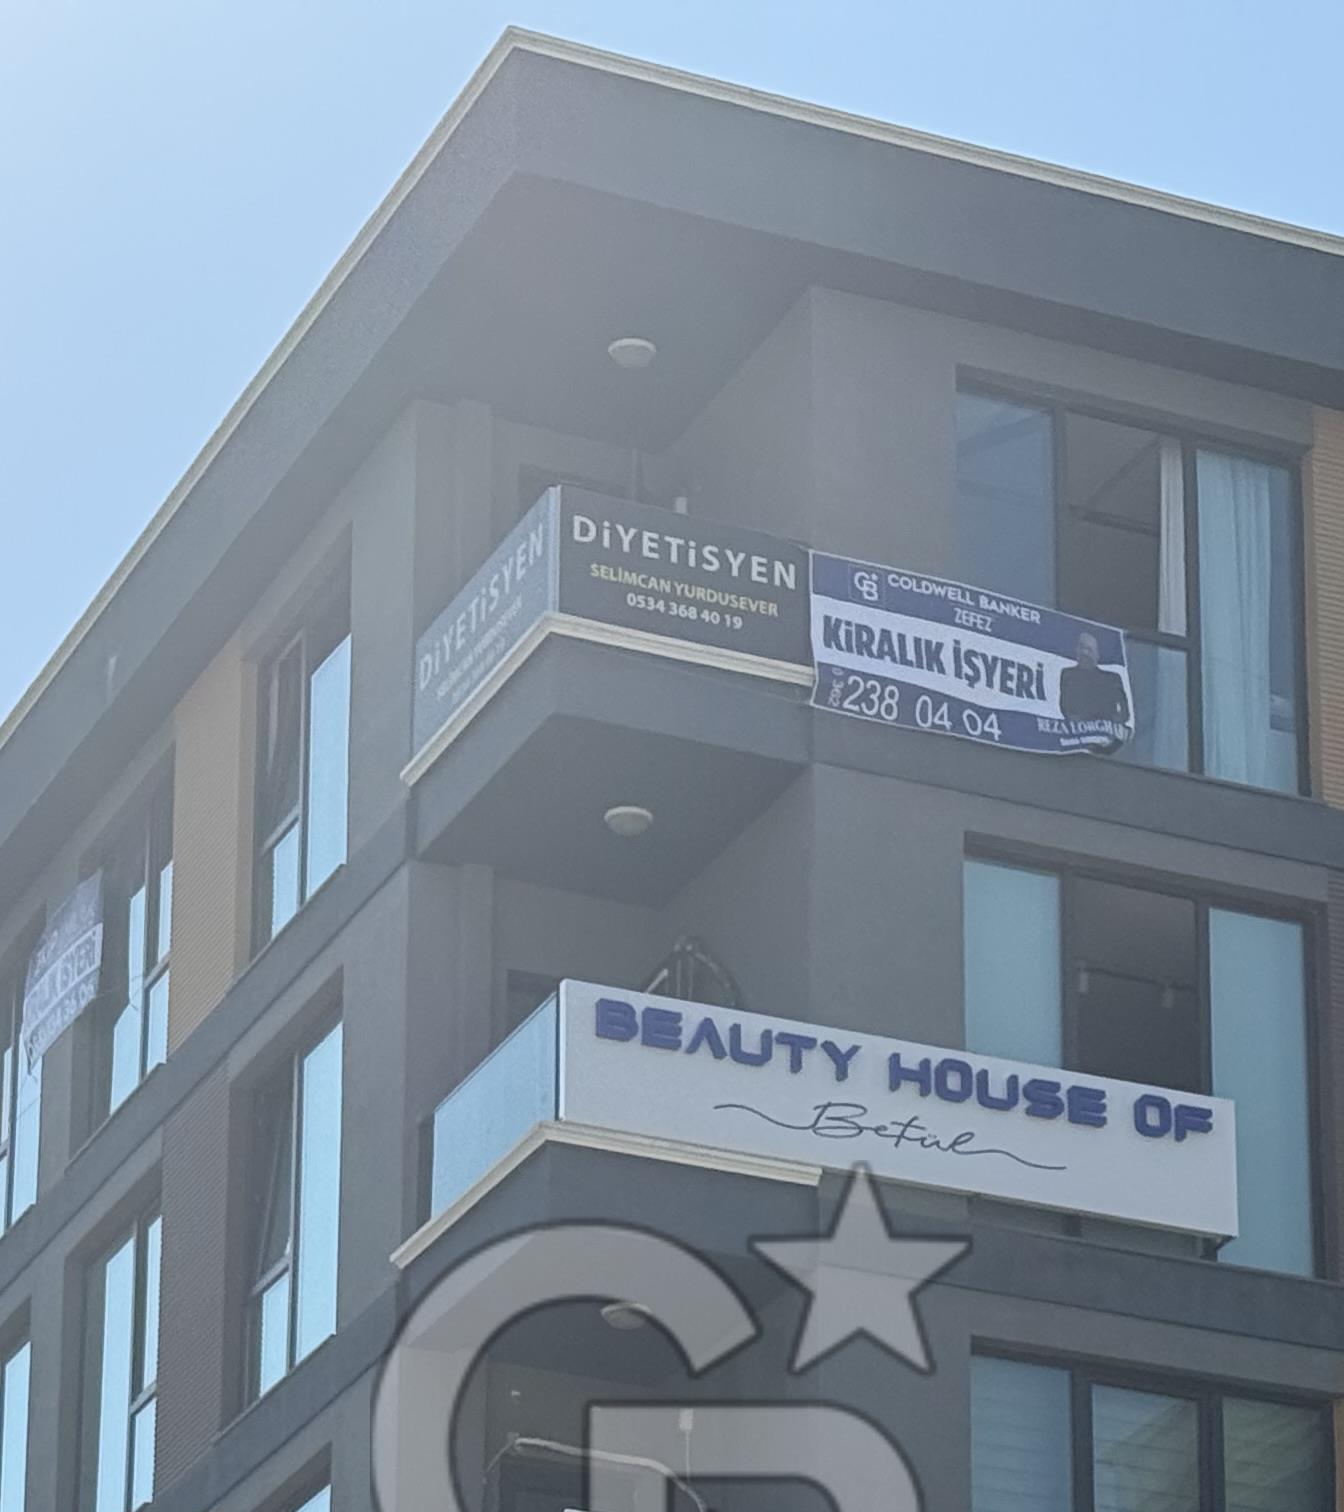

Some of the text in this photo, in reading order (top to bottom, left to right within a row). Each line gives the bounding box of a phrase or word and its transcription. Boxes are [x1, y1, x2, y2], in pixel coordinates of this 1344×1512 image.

[590, 563, 779, 618] SELİMCAN YURDUSEVER
[626, 592, 744, 630] 0534 368 40 19
[887, 573, 974, 606] COLDWELL
[979, 595, 1041, 625] BANKER
[954, 607, 993, 632] ZEFEZ
[843, 675, 1002, 741] 238 04 04
[594, 998, 1214, 1142] BEAUTY HOUSE OF
